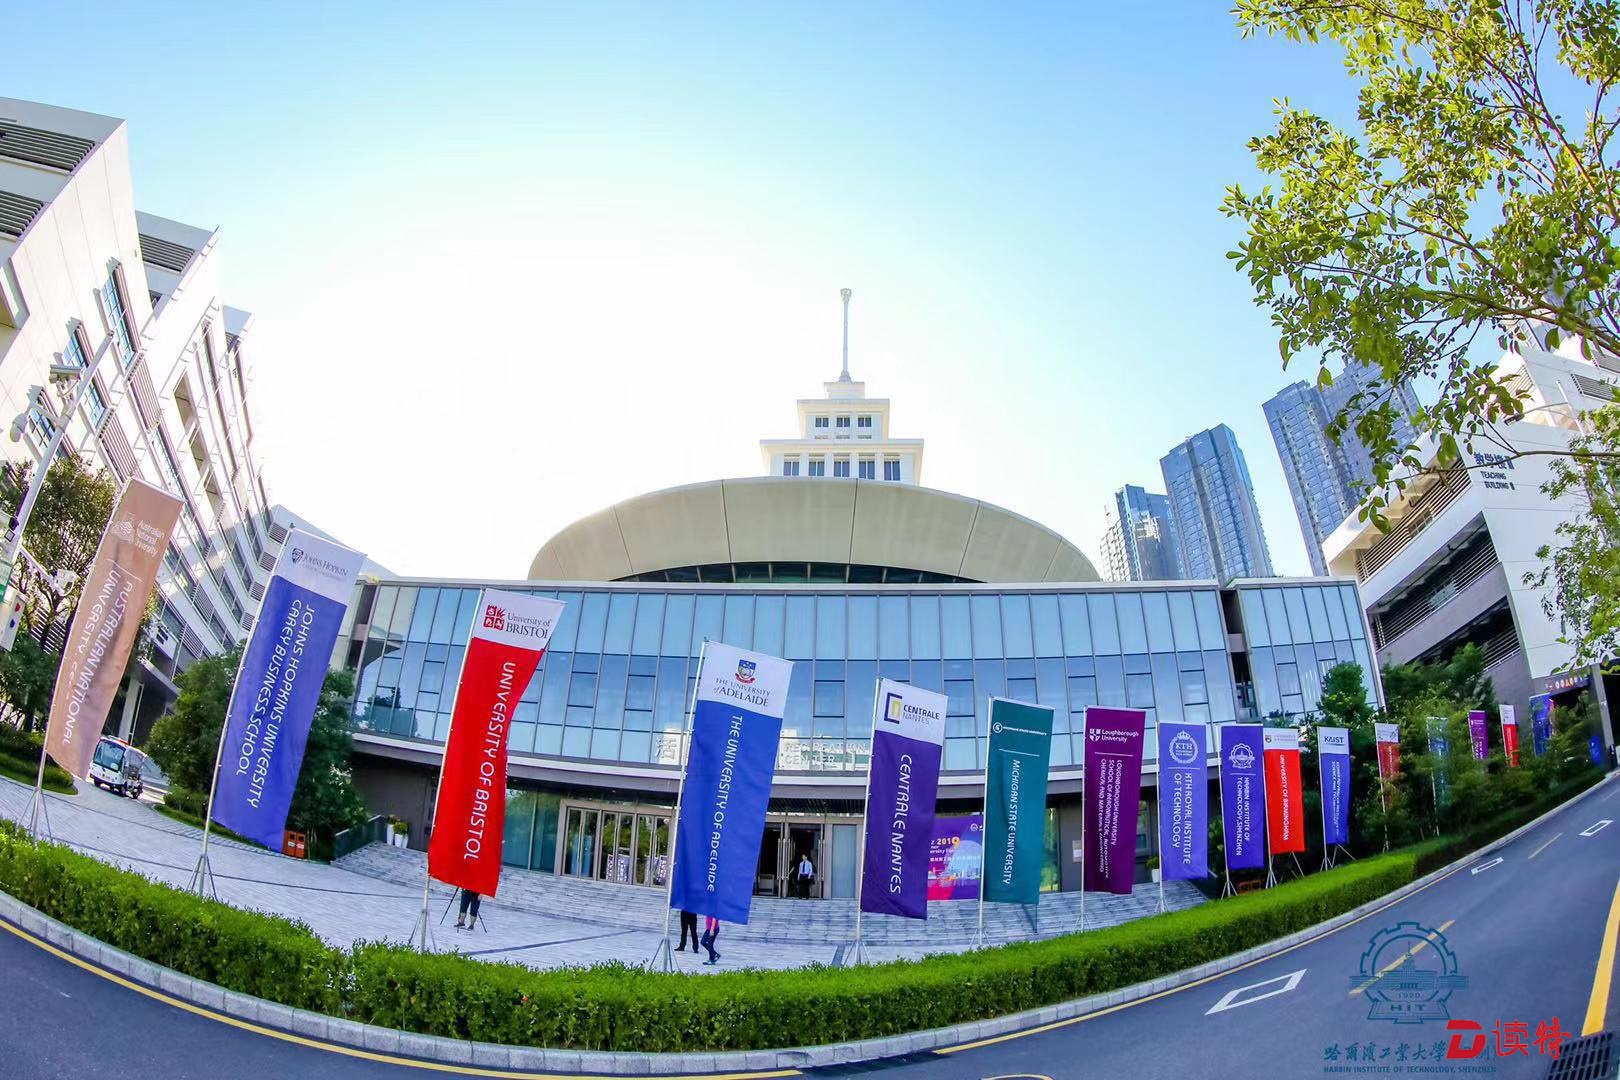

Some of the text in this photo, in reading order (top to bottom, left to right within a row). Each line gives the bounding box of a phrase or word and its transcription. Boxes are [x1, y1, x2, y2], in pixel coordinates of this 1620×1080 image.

[1480, 471, 1506, 480] TEACHING
[78, 570, 121, 654] UNIVERSITY
[507, 612, 552, 627] University of
[62, 581, 132, 745] AUSTRALIAN NATIONAL
[236, 599, 301, 776] CAREY BUSINESS SCHOOL
[716, 678, 771, 697] THE UNIVERSITY
[719, 687, 768, 707] ADELAIDE
[247, 604, 315, 808] JOHNS HOPKINS UNIVERSITY
[903, 704, 940, 720] CENTRALE
[903, 712, 930, 725] NANTES
[1102, 729, 1139, 738] Loughborough
[1102, 735, 1127, 743] University
[464, 662, 516, 860] UNIVERSITY OF BRISTOL
[785, 755, 835, 765] CENTER
[1280, 754, 1288, 788] UNIVERSITY
[707, 715, 743, 893] THE UNIVERSITY OF ADELAIDE
[1172, 773, 1182, 848] OF TECHNOLOGY
[890, 754, 912, 894] CENTRALE NANTES
[1002, 759, 1020, 885] MICHIGAN STATE UNIVERSITY
[1244, 832, 1250, 841] OF
[1183, 820, 1192, 864] INSTITUTE
